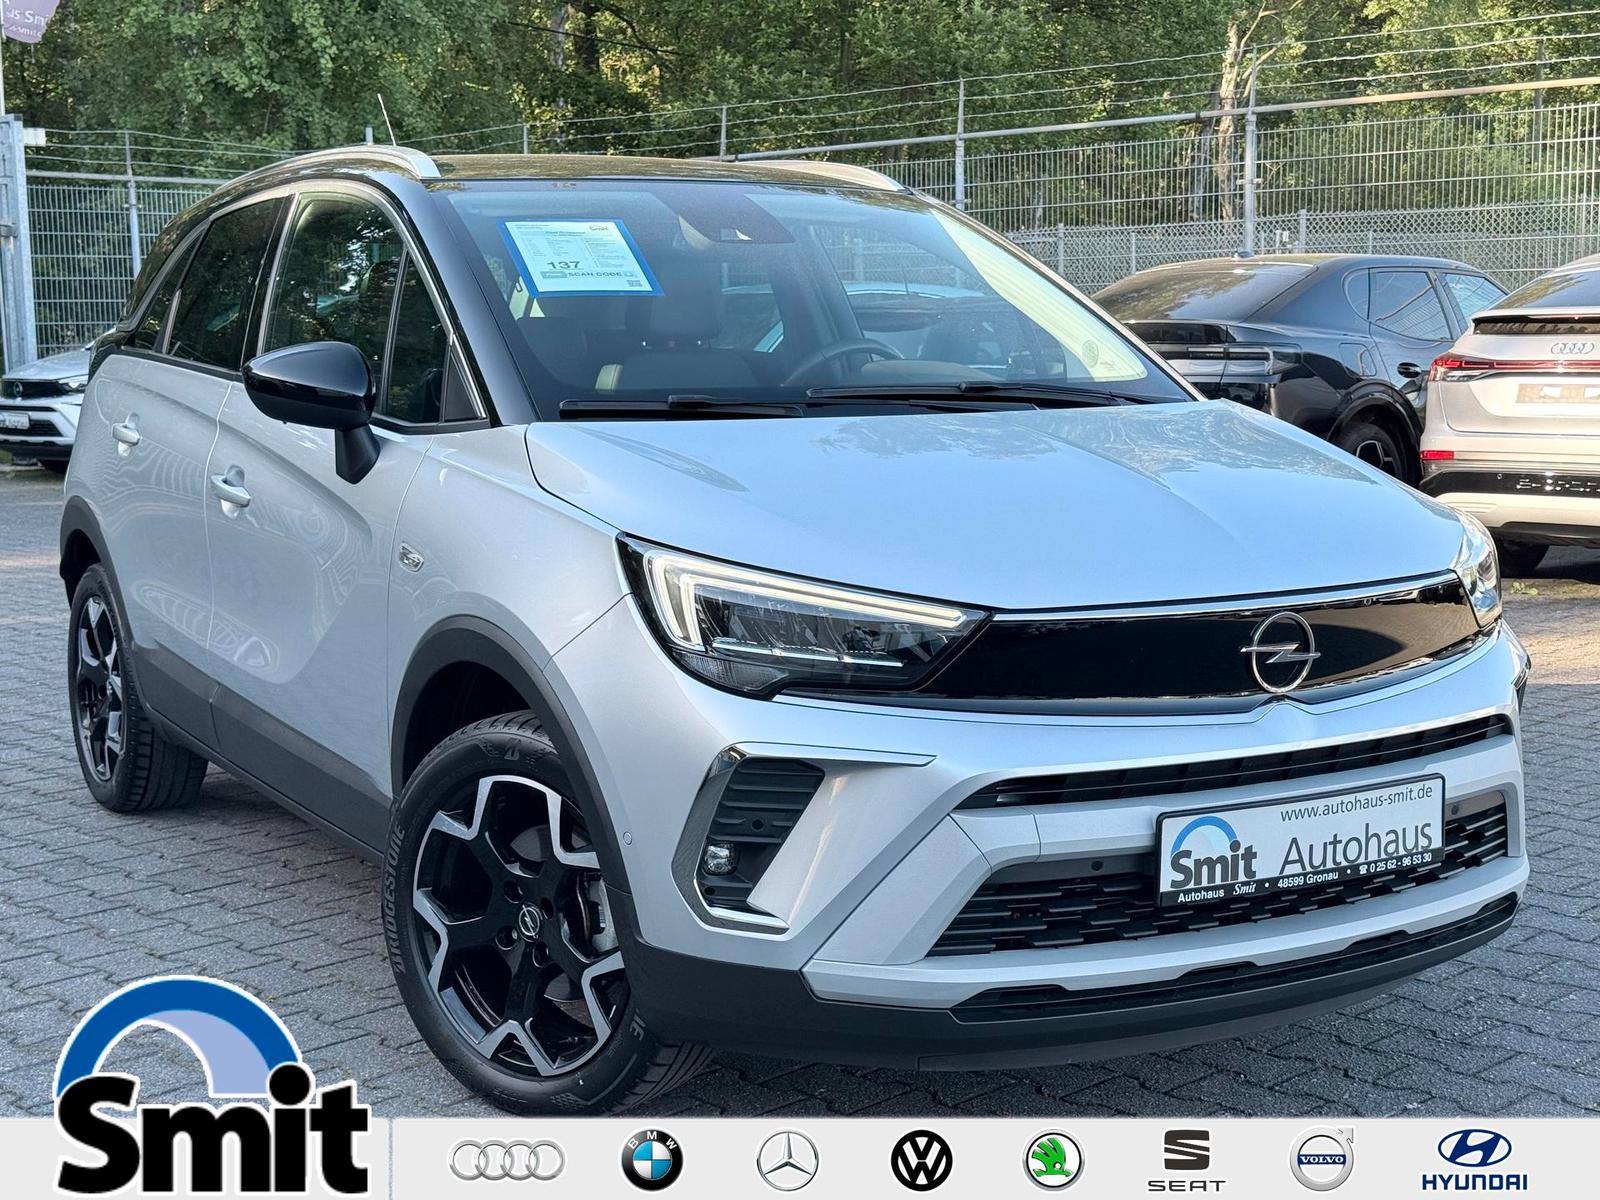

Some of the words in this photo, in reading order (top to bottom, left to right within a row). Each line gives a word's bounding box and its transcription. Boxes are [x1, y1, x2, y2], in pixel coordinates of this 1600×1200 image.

[547, 261, 580, 269] 137
[1280, 783, 1433, 822] www.autohaus-smit.de
[1170, 839, 1258, 889] Smit
[1278, 822, 1433, 875] Autohaus
[1177, 889, 1225, 903] Autohaus
[1232, 882, 1257, 895] Smit
[1277, 876, 1304, 889] 48599
[1306, 870, 1339, 884] Gronau
